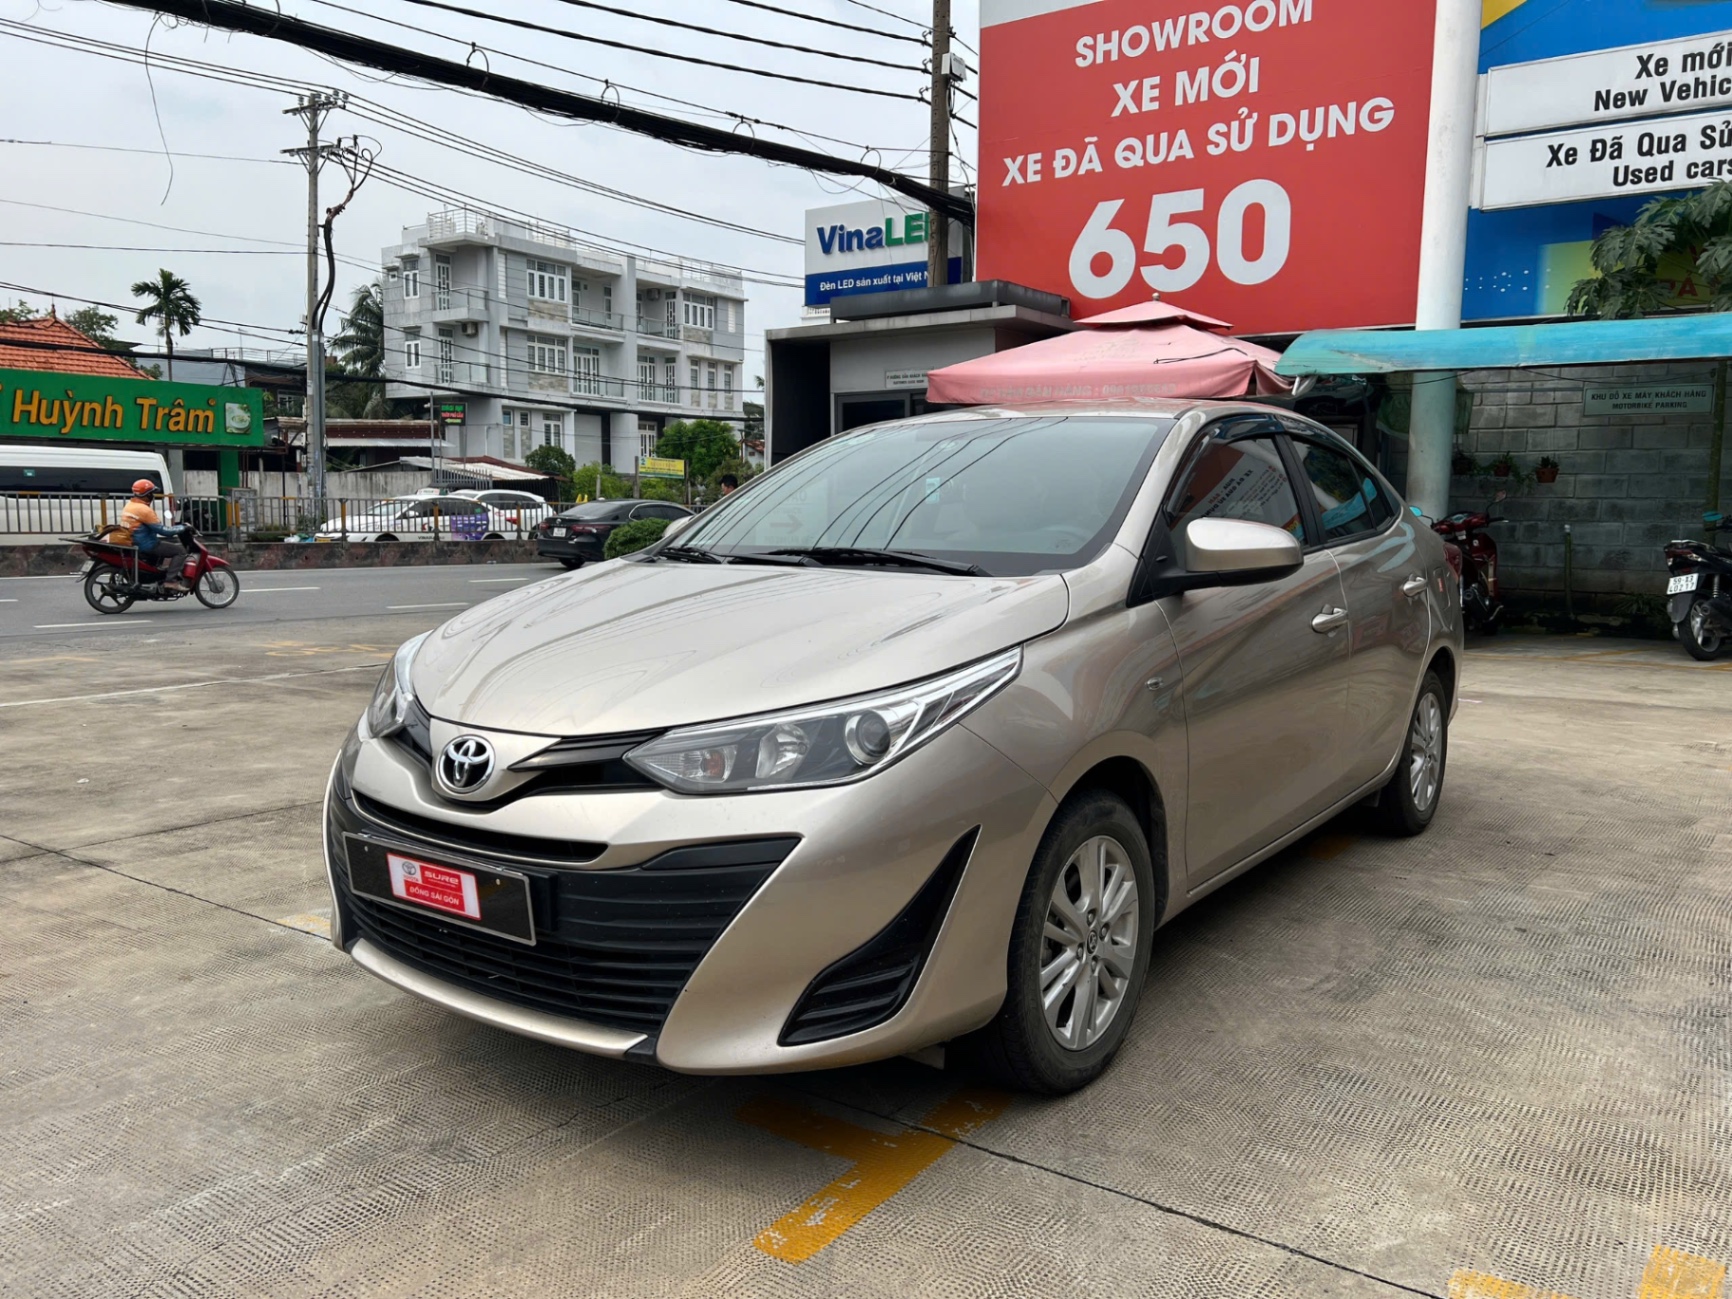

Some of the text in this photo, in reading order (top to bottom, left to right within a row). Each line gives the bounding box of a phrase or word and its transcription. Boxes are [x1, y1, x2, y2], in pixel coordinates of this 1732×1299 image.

[1075, 0, 1313, 68] SHOWROOM
[1635, 42, 1732, 80] Xe mới
[1111, 50, 1260, 117] XE MỚI
[1594, 88, 1648, 112] New
[1002, 97, 1395, 187] XE ĐÃ QUA SỬ DỤNG
[1546, 143, 1578, 168] Xe
[1590, 135, 1623, 163] Đã
[1637, 132, 1687, 158] Qua
[1612, 160, 1674, 187] Used
[816, 212, 929, 255] VinaLE
[1068, 178, 1291, 299] 650
[820, 280, 836, 291] Đèn
[838, 278, 854, 289] LED
[856, 277, 871, 288] sản
[873, 273, 891, 286] xuất
[893, 273, 904, 285] tại
[905, 271, 922, 283] Việt
[12, 389, 214, 434] Huỳnh Trâm
[1612, 401, 1688, 410] MOTORBIKE PARKING
[1622, 392, 1633, 400] XE
[1655, 390, 1681, 399] KHÁCH
[409, 885, 429, 897] ĐÔNG
